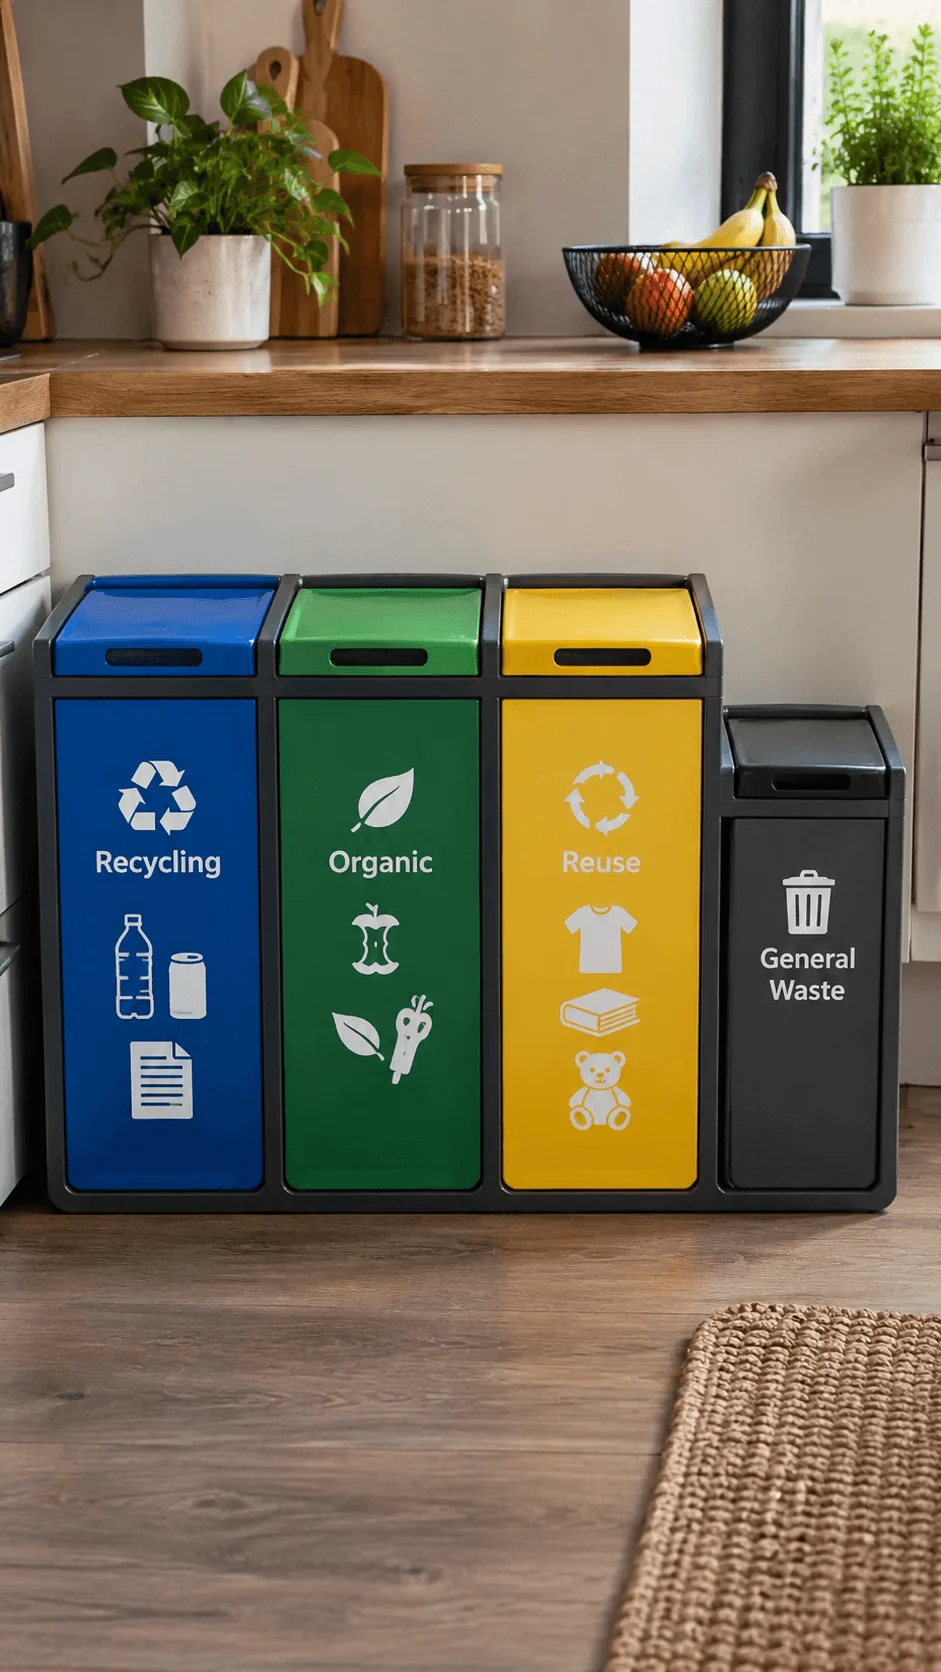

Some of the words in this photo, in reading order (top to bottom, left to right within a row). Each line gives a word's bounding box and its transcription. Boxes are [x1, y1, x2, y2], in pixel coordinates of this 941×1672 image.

[96, 849, 221, 879] Recycling
[328, 849, 433, 879] Organic
[562, 850, 641, 874] Reuse
[760, 947, 856, 969] General
[769, 979, 845, 1001] Waste
